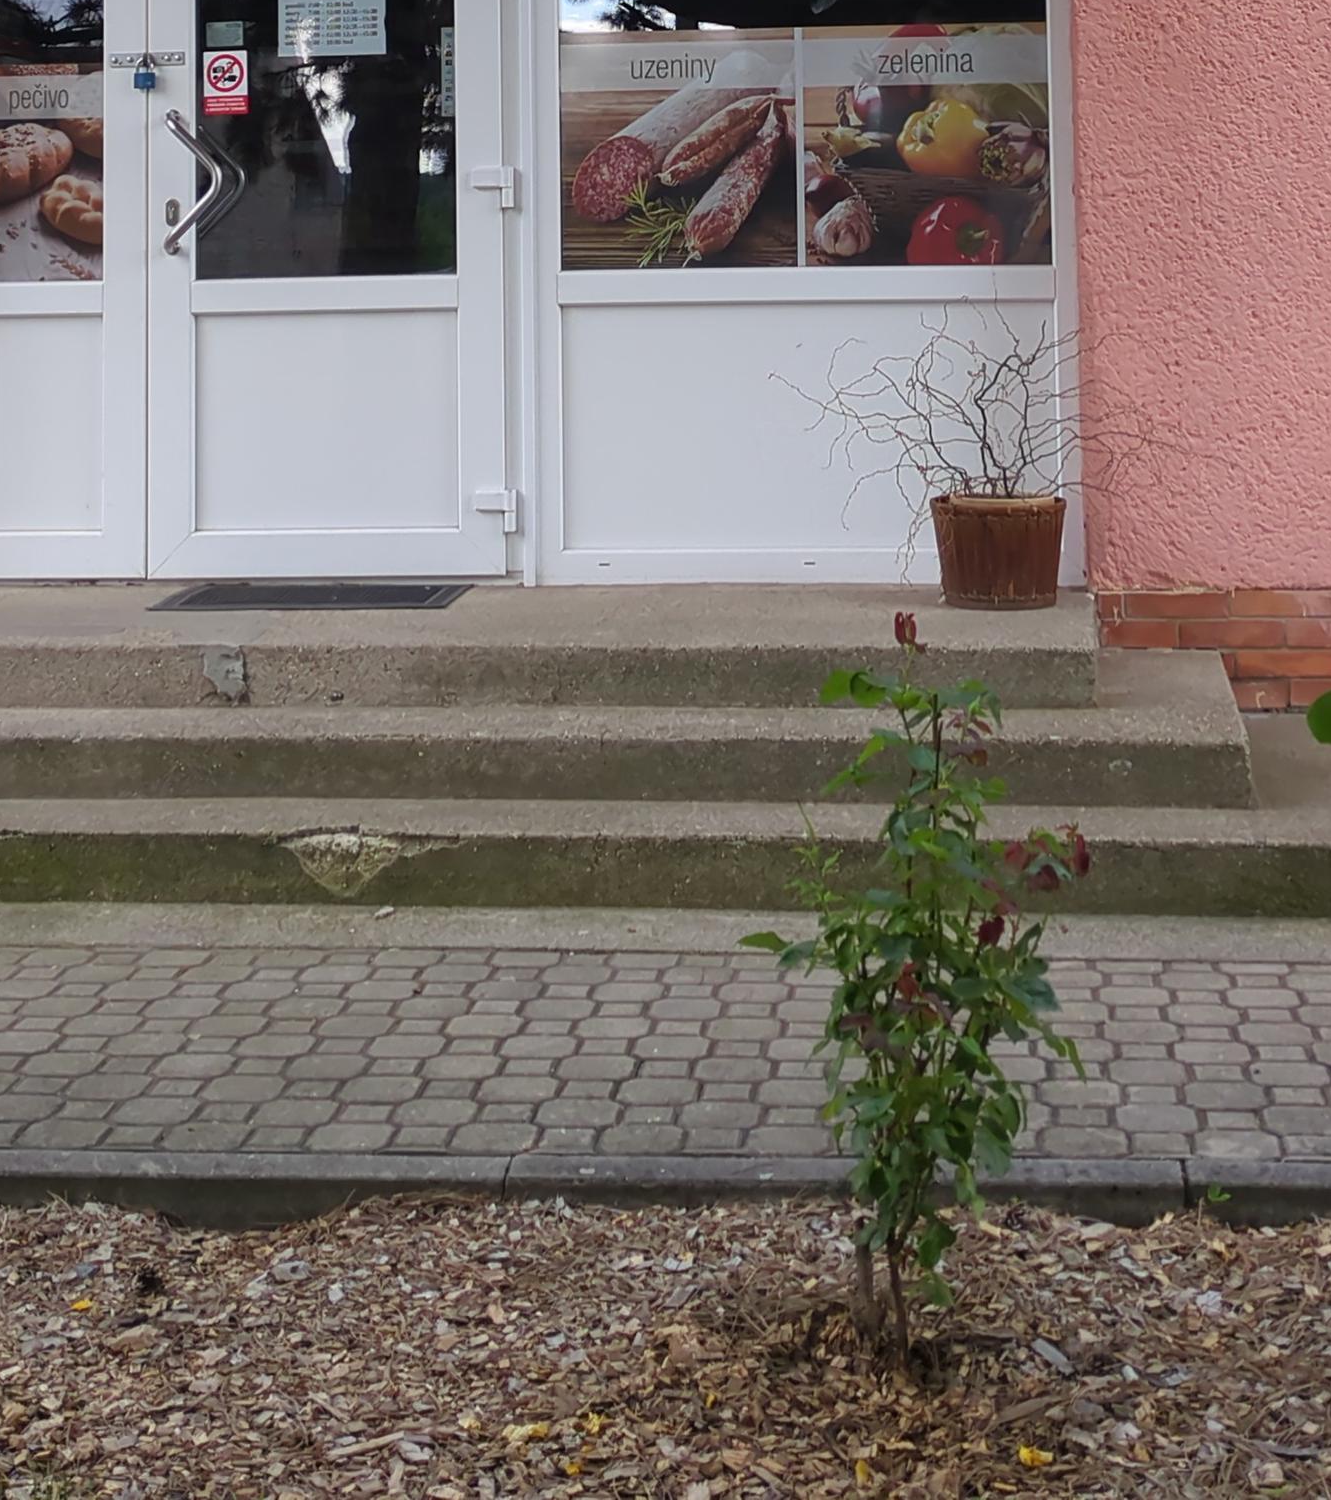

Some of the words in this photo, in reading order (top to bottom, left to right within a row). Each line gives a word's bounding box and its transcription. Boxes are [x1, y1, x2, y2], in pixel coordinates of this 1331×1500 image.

[629, 52, 716, 84] uzeniny
[877, 48, 974, 75] zelenina
[9, 84, 69, 115] pečivo
